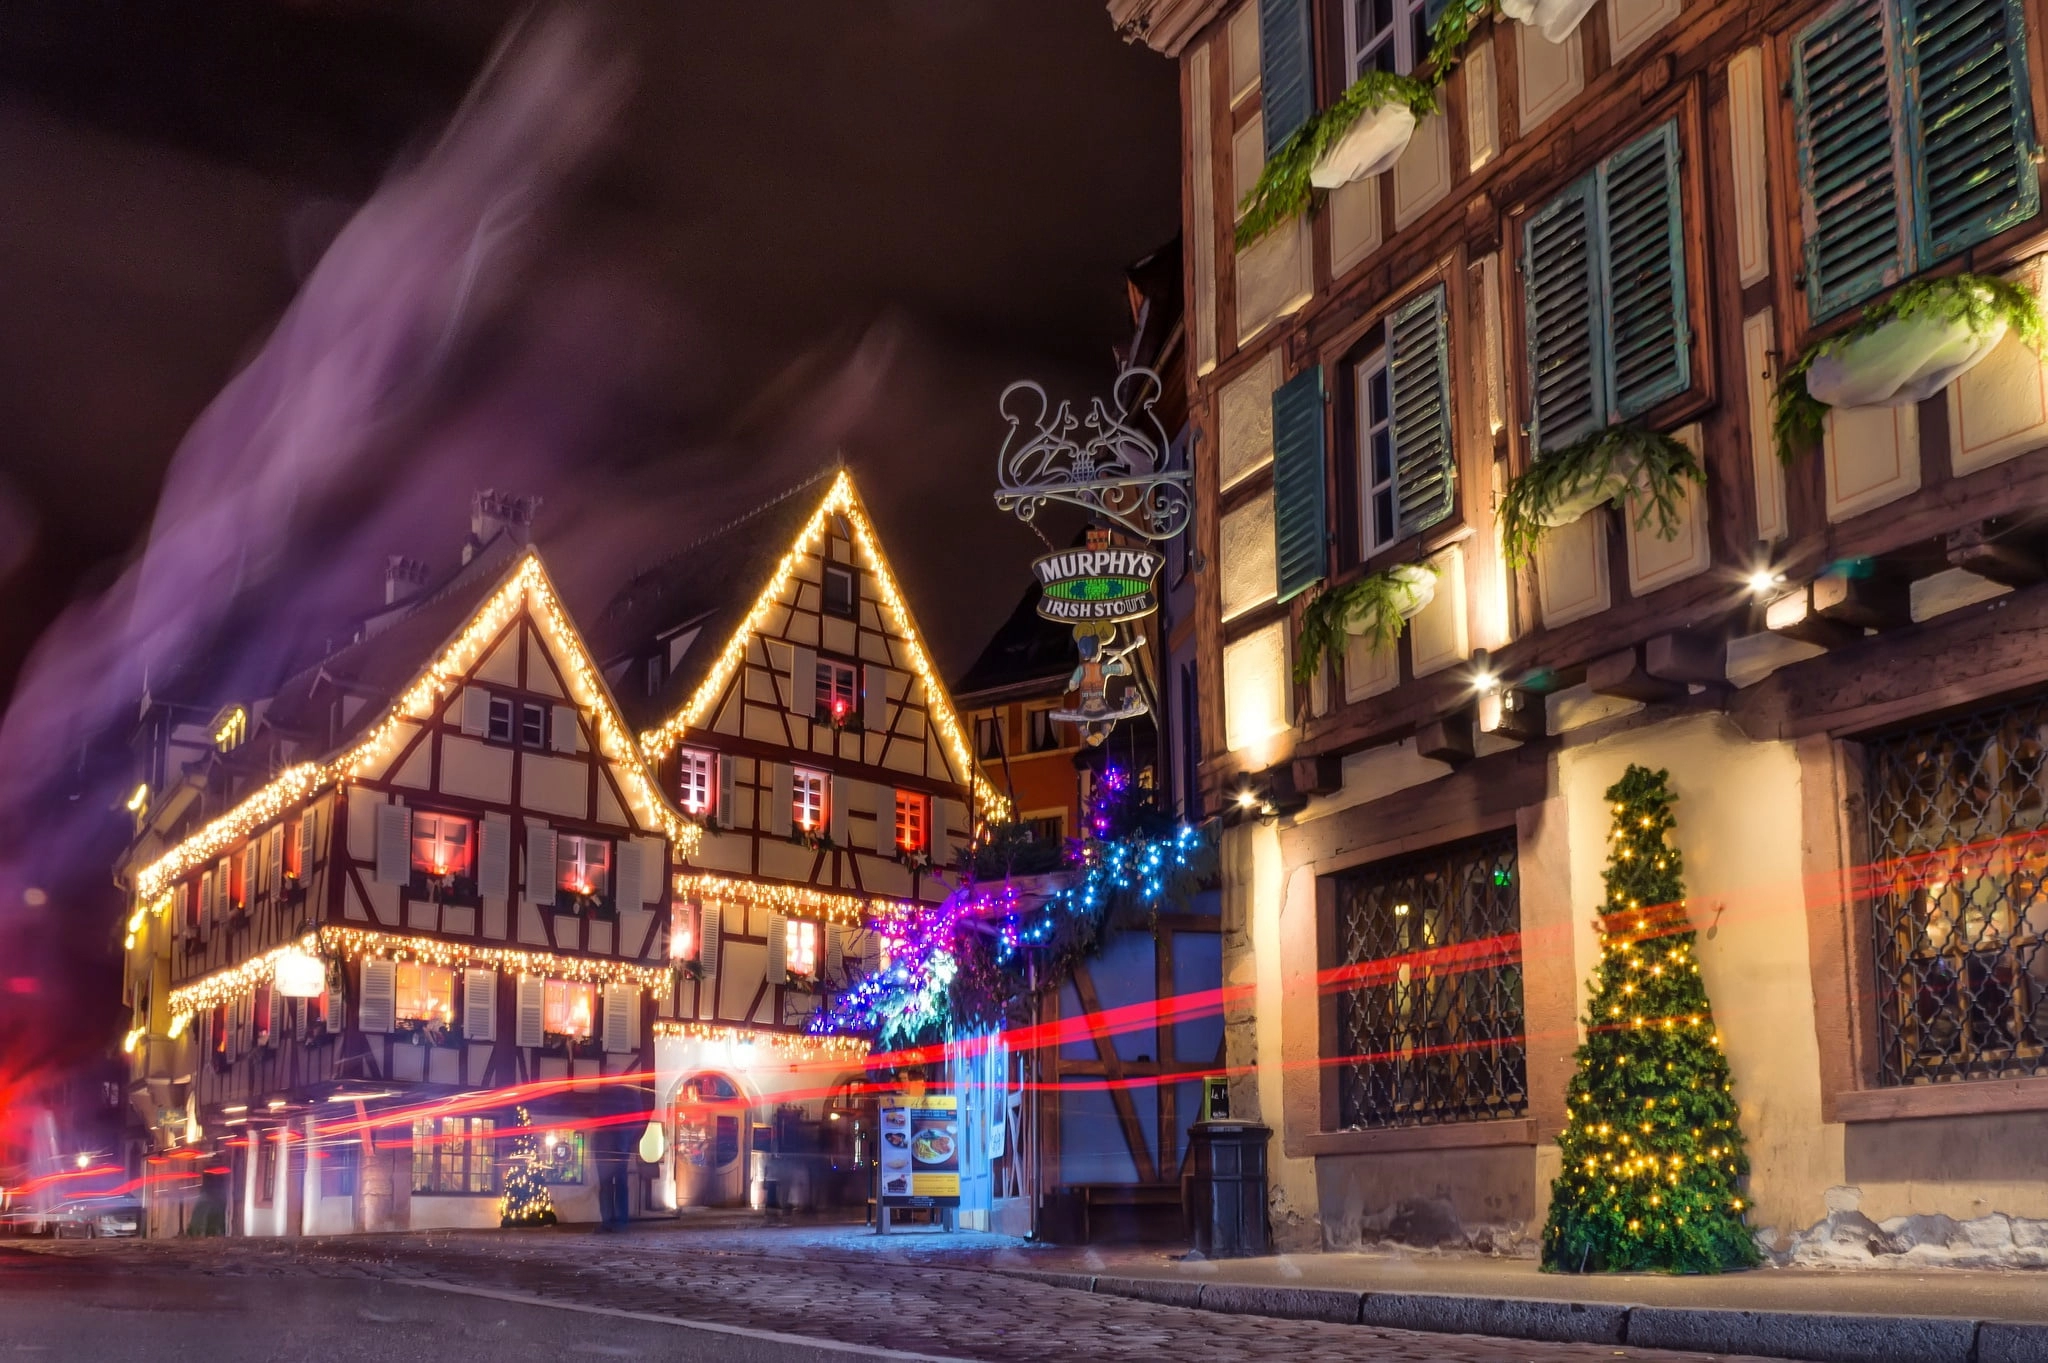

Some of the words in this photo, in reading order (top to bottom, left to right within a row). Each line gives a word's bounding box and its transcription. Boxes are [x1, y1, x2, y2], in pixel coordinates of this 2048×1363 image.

[1039, 550, 1154, 583] MURPHY'S
[1045, 599, 1091, 618] IRISH
[1094, 595, 1147, 617] STOUT
